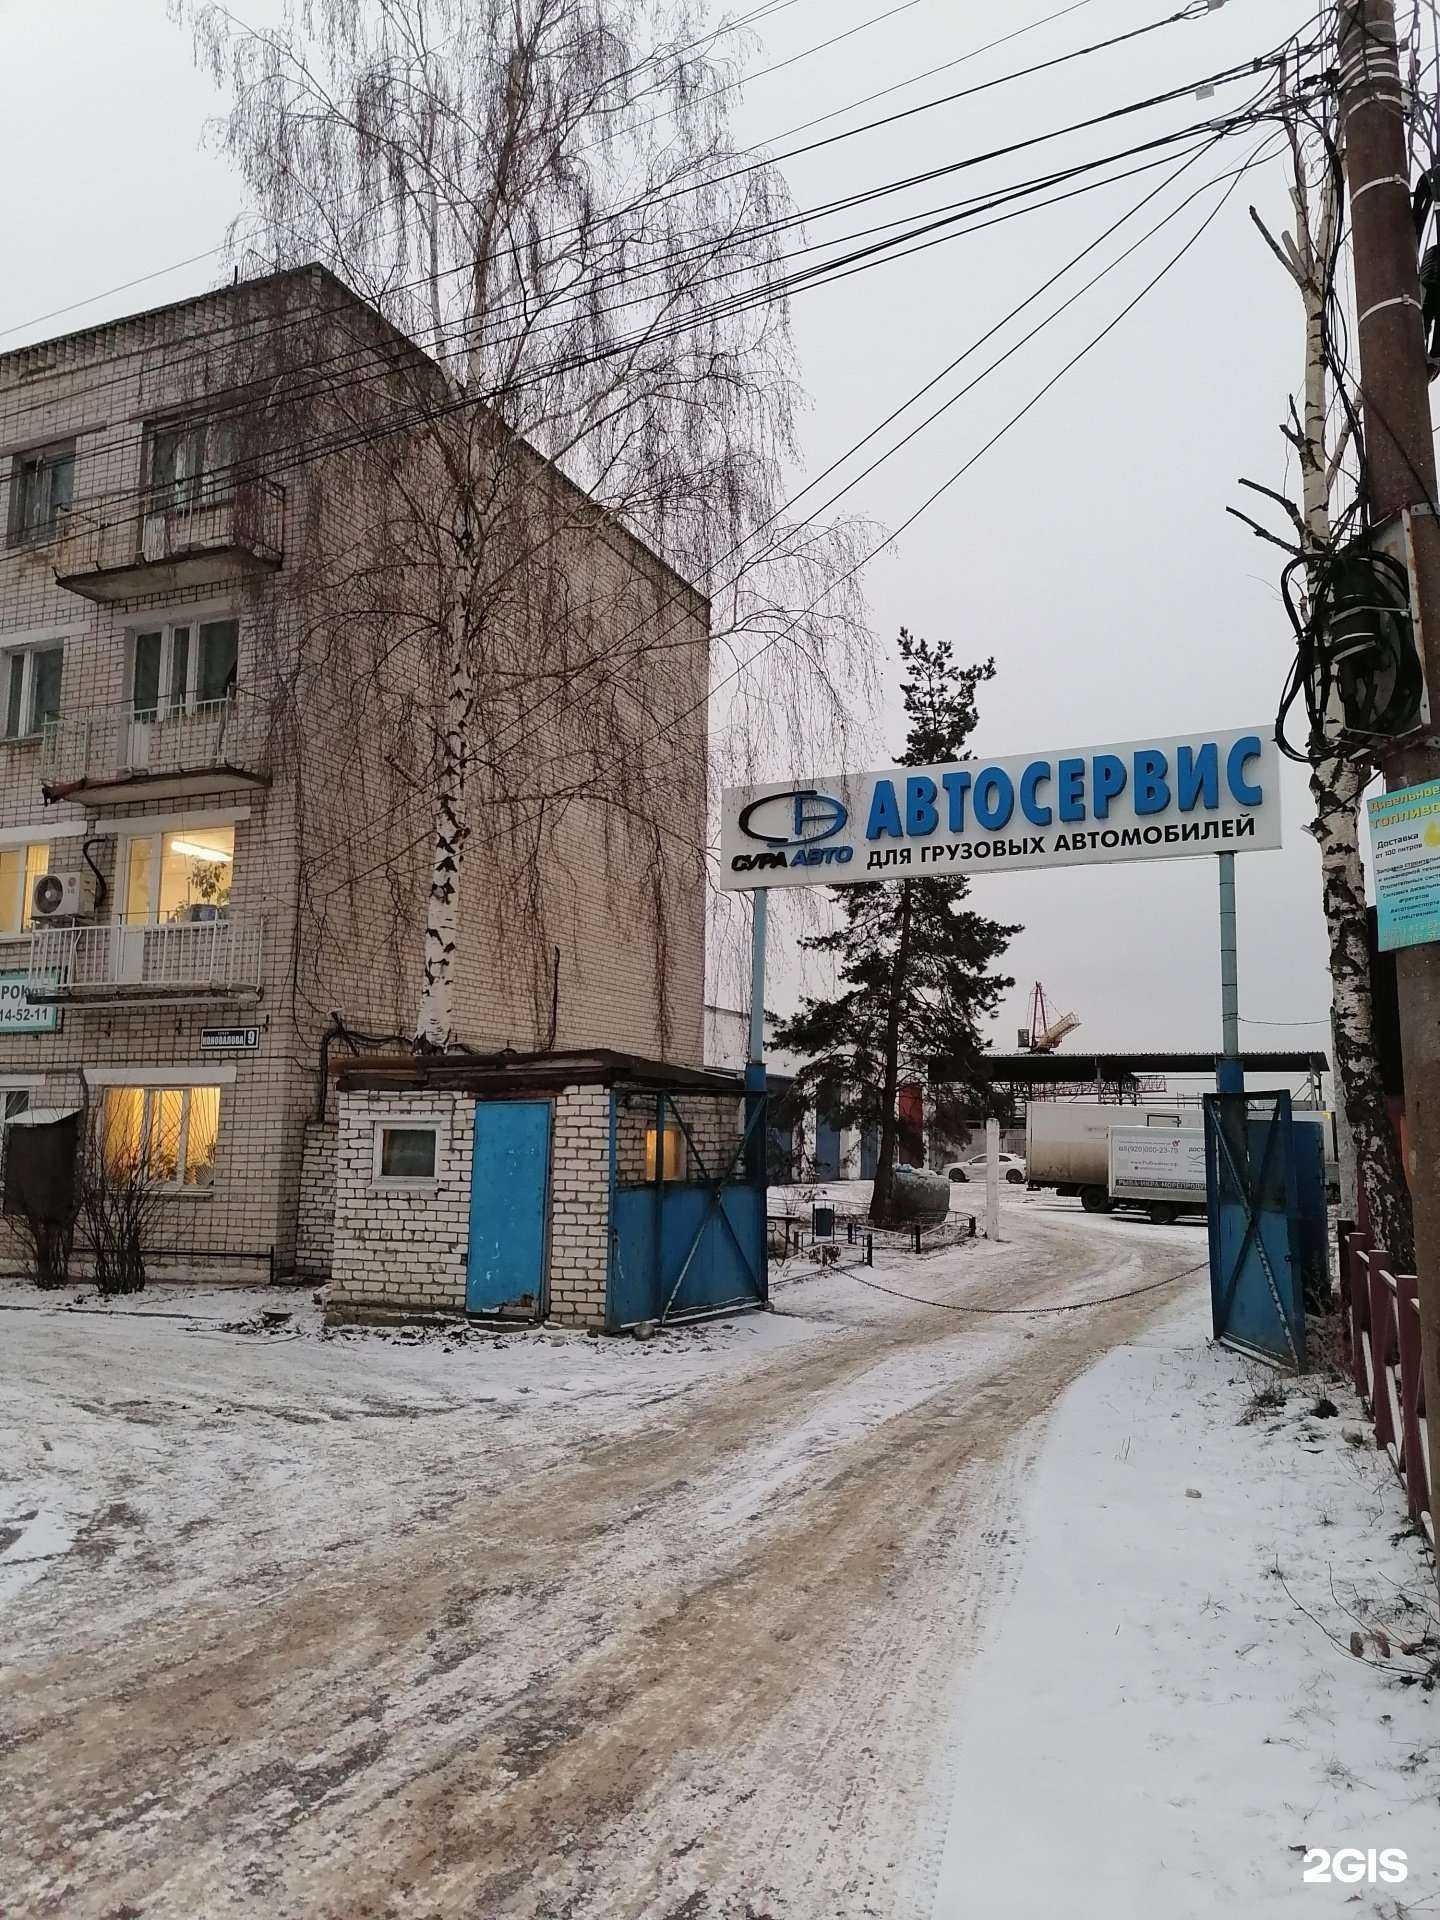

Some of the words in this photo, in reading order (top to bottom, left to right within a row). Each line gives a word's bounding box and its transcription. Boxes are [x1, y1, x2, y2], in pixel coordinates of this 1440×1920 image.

[866, 736, 1263, 840] АВТОСЕРВИС
[866, 848, 912, 871] ДЛЯ
[921, 836, 1046, 863] ГРУЗОВЫХ
[1053, 813, 1256, 852] АВТОМОБИЛЕЙ
[1376, 833, 1419, 850] Доставка
[731, 851, 788, 872] СУРА
[789, 845, 854, 868] АВТО
[247, 1030, 255, 1045] 9
